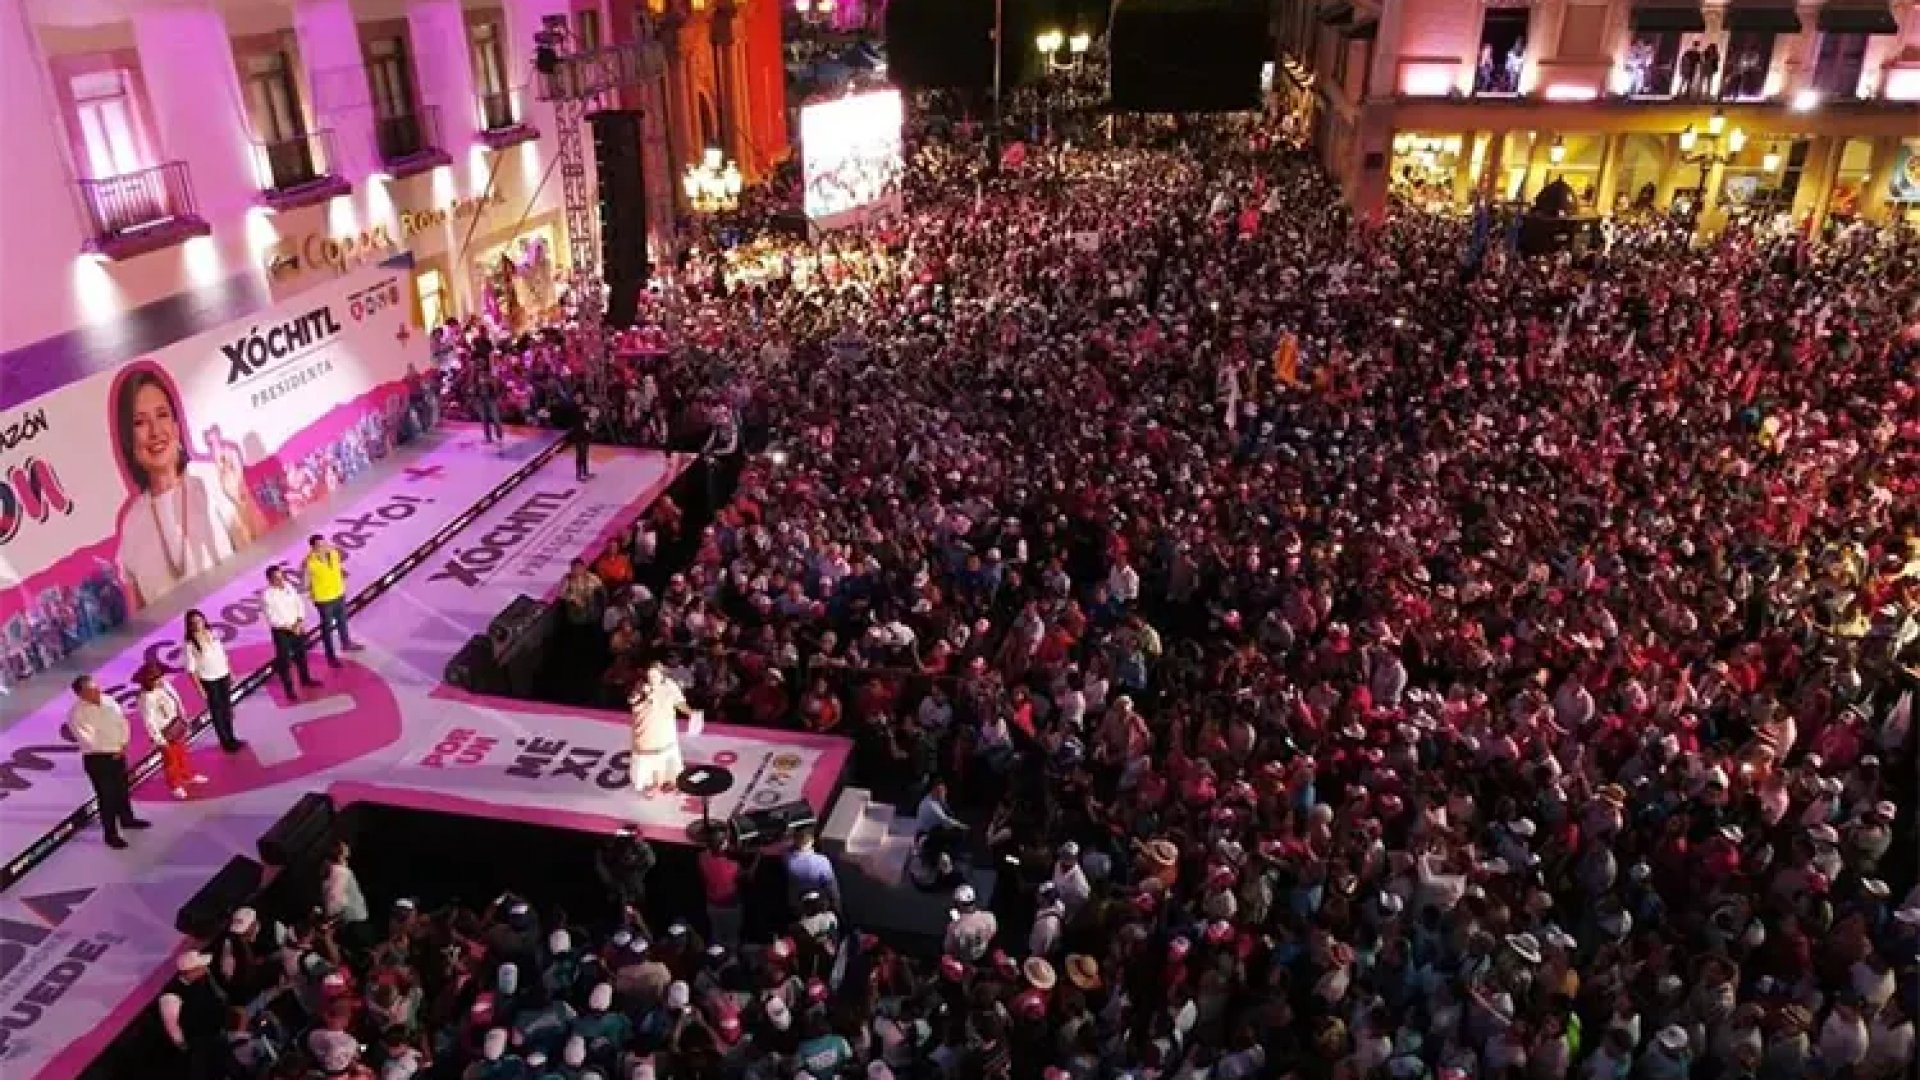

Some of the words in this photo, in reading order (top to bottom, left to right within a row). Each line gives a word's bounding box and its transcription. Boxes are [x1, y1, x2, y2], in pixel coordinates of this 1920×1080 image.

[220, 305, 342, 385] XÓCHITL
[250, 359, 334, 408] PRESIDENTA
[427, 488, 577, 587] XÓCHITL
[418, 728, 477, 768] POR
[455, 736, 498, 764] UN
